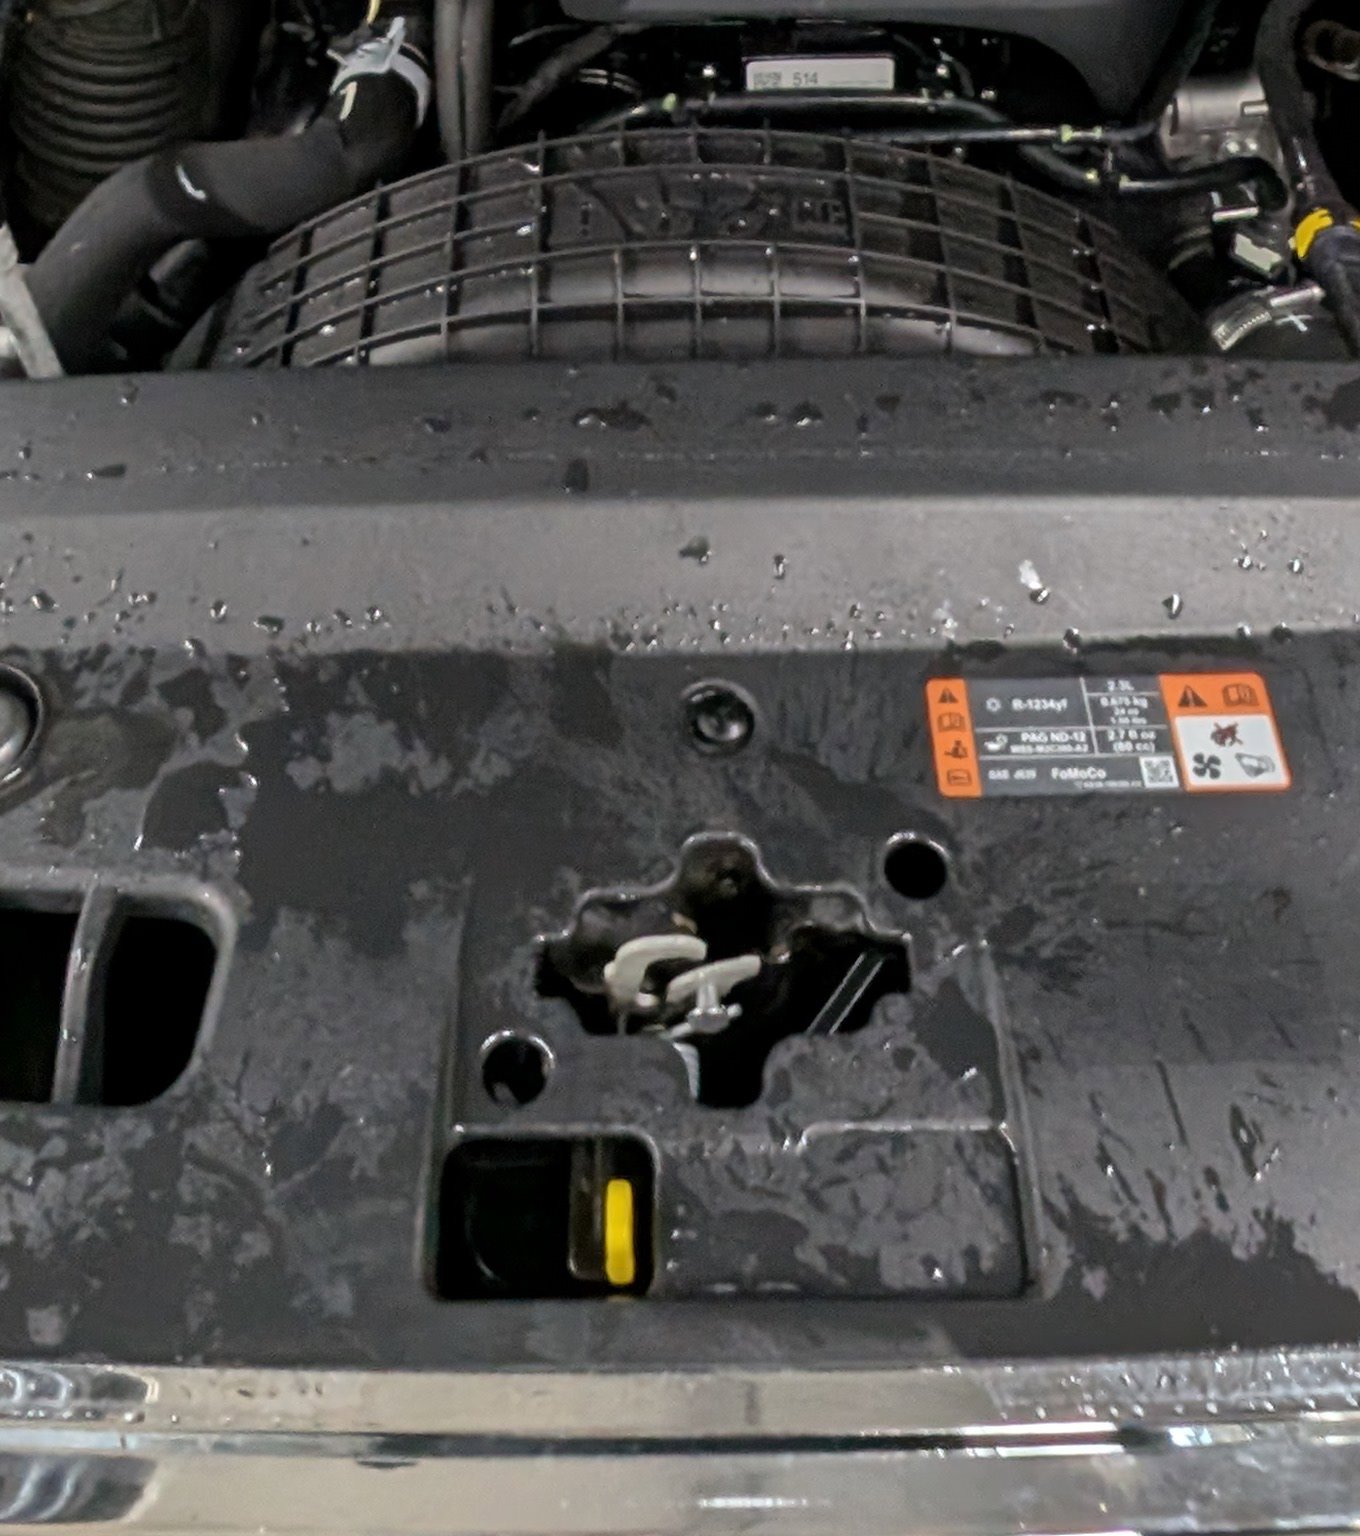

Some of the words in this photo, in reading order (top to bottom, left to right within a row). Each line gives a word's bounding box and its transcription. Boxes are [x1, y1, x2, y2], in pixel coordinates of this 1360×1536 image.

[1011, 696, 1068, 714] R-1234yf
[1020, 731, 1049, 743] PAG
[1051, 766, 1107, 780] FoMoCo
